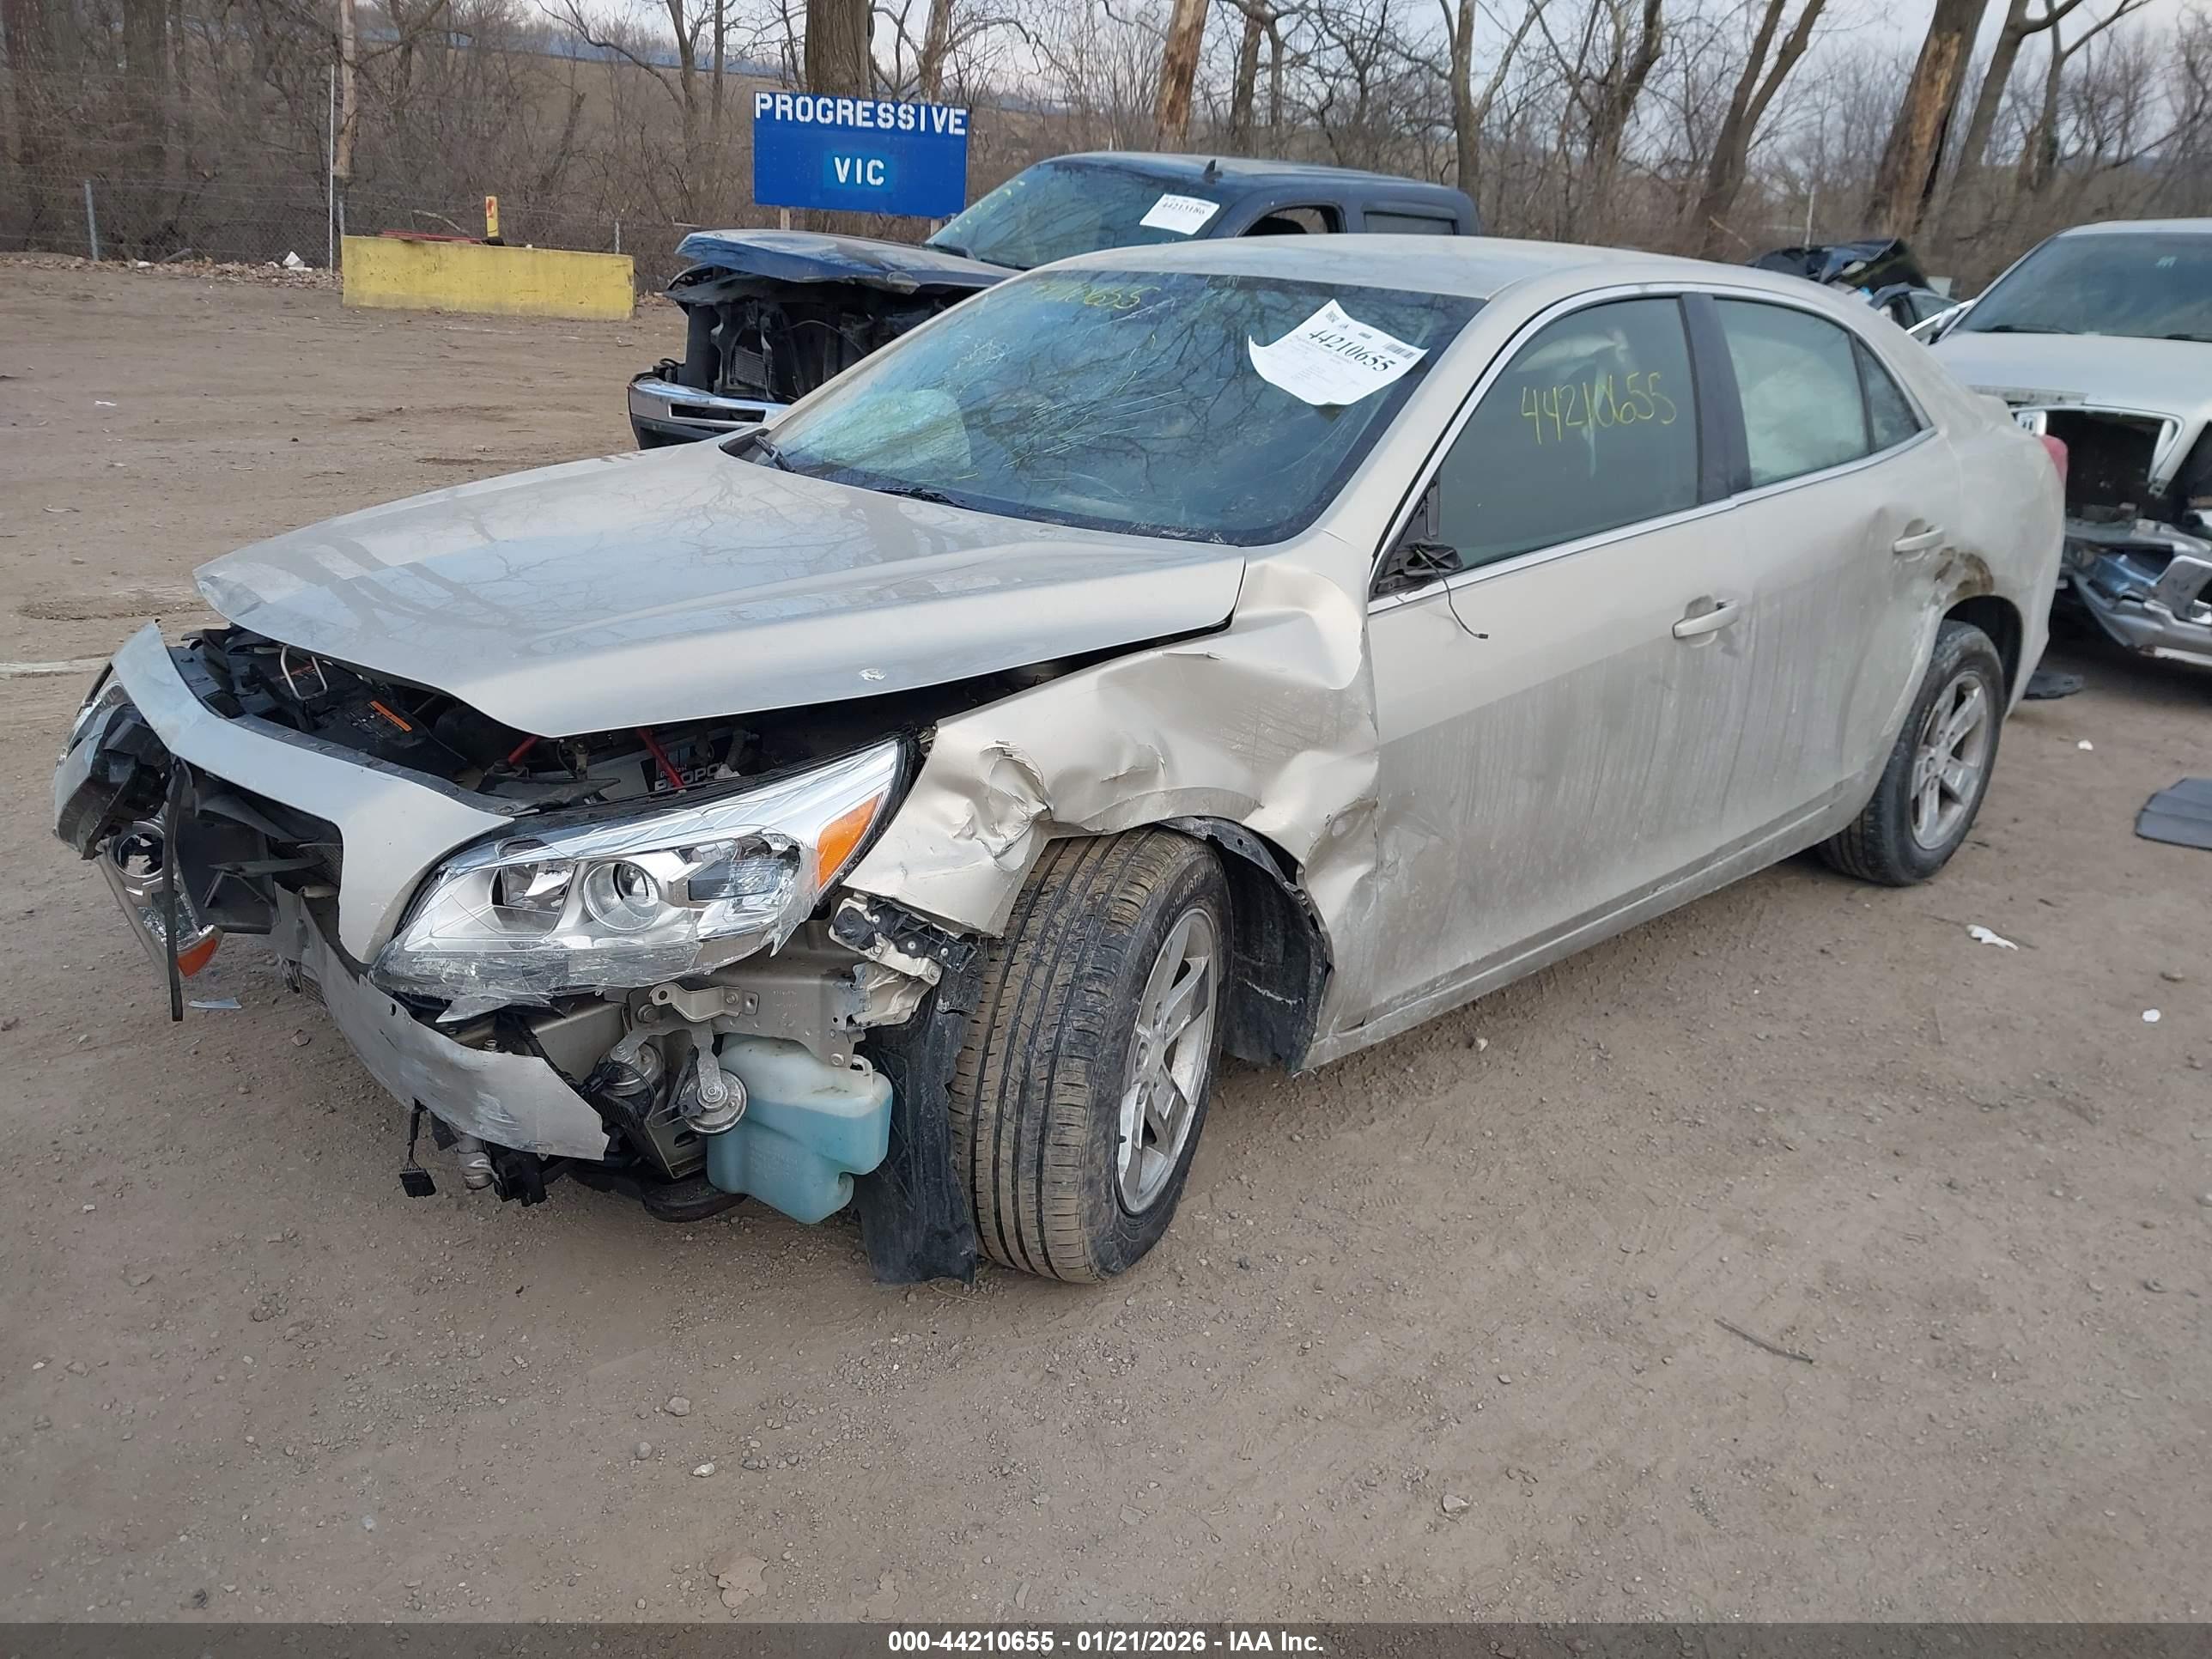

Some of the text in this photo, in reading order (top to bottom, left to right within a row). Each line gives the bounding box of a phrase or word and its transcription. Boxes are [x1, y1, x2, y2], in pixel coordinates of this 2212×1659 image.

[755, 93, 967, 136] PROGRESSIVE
[834, 156, 885, 186] VIC
[1309, 330, 1397, 372] 44210655
[1521, 372, 1677, 445] 44210655
